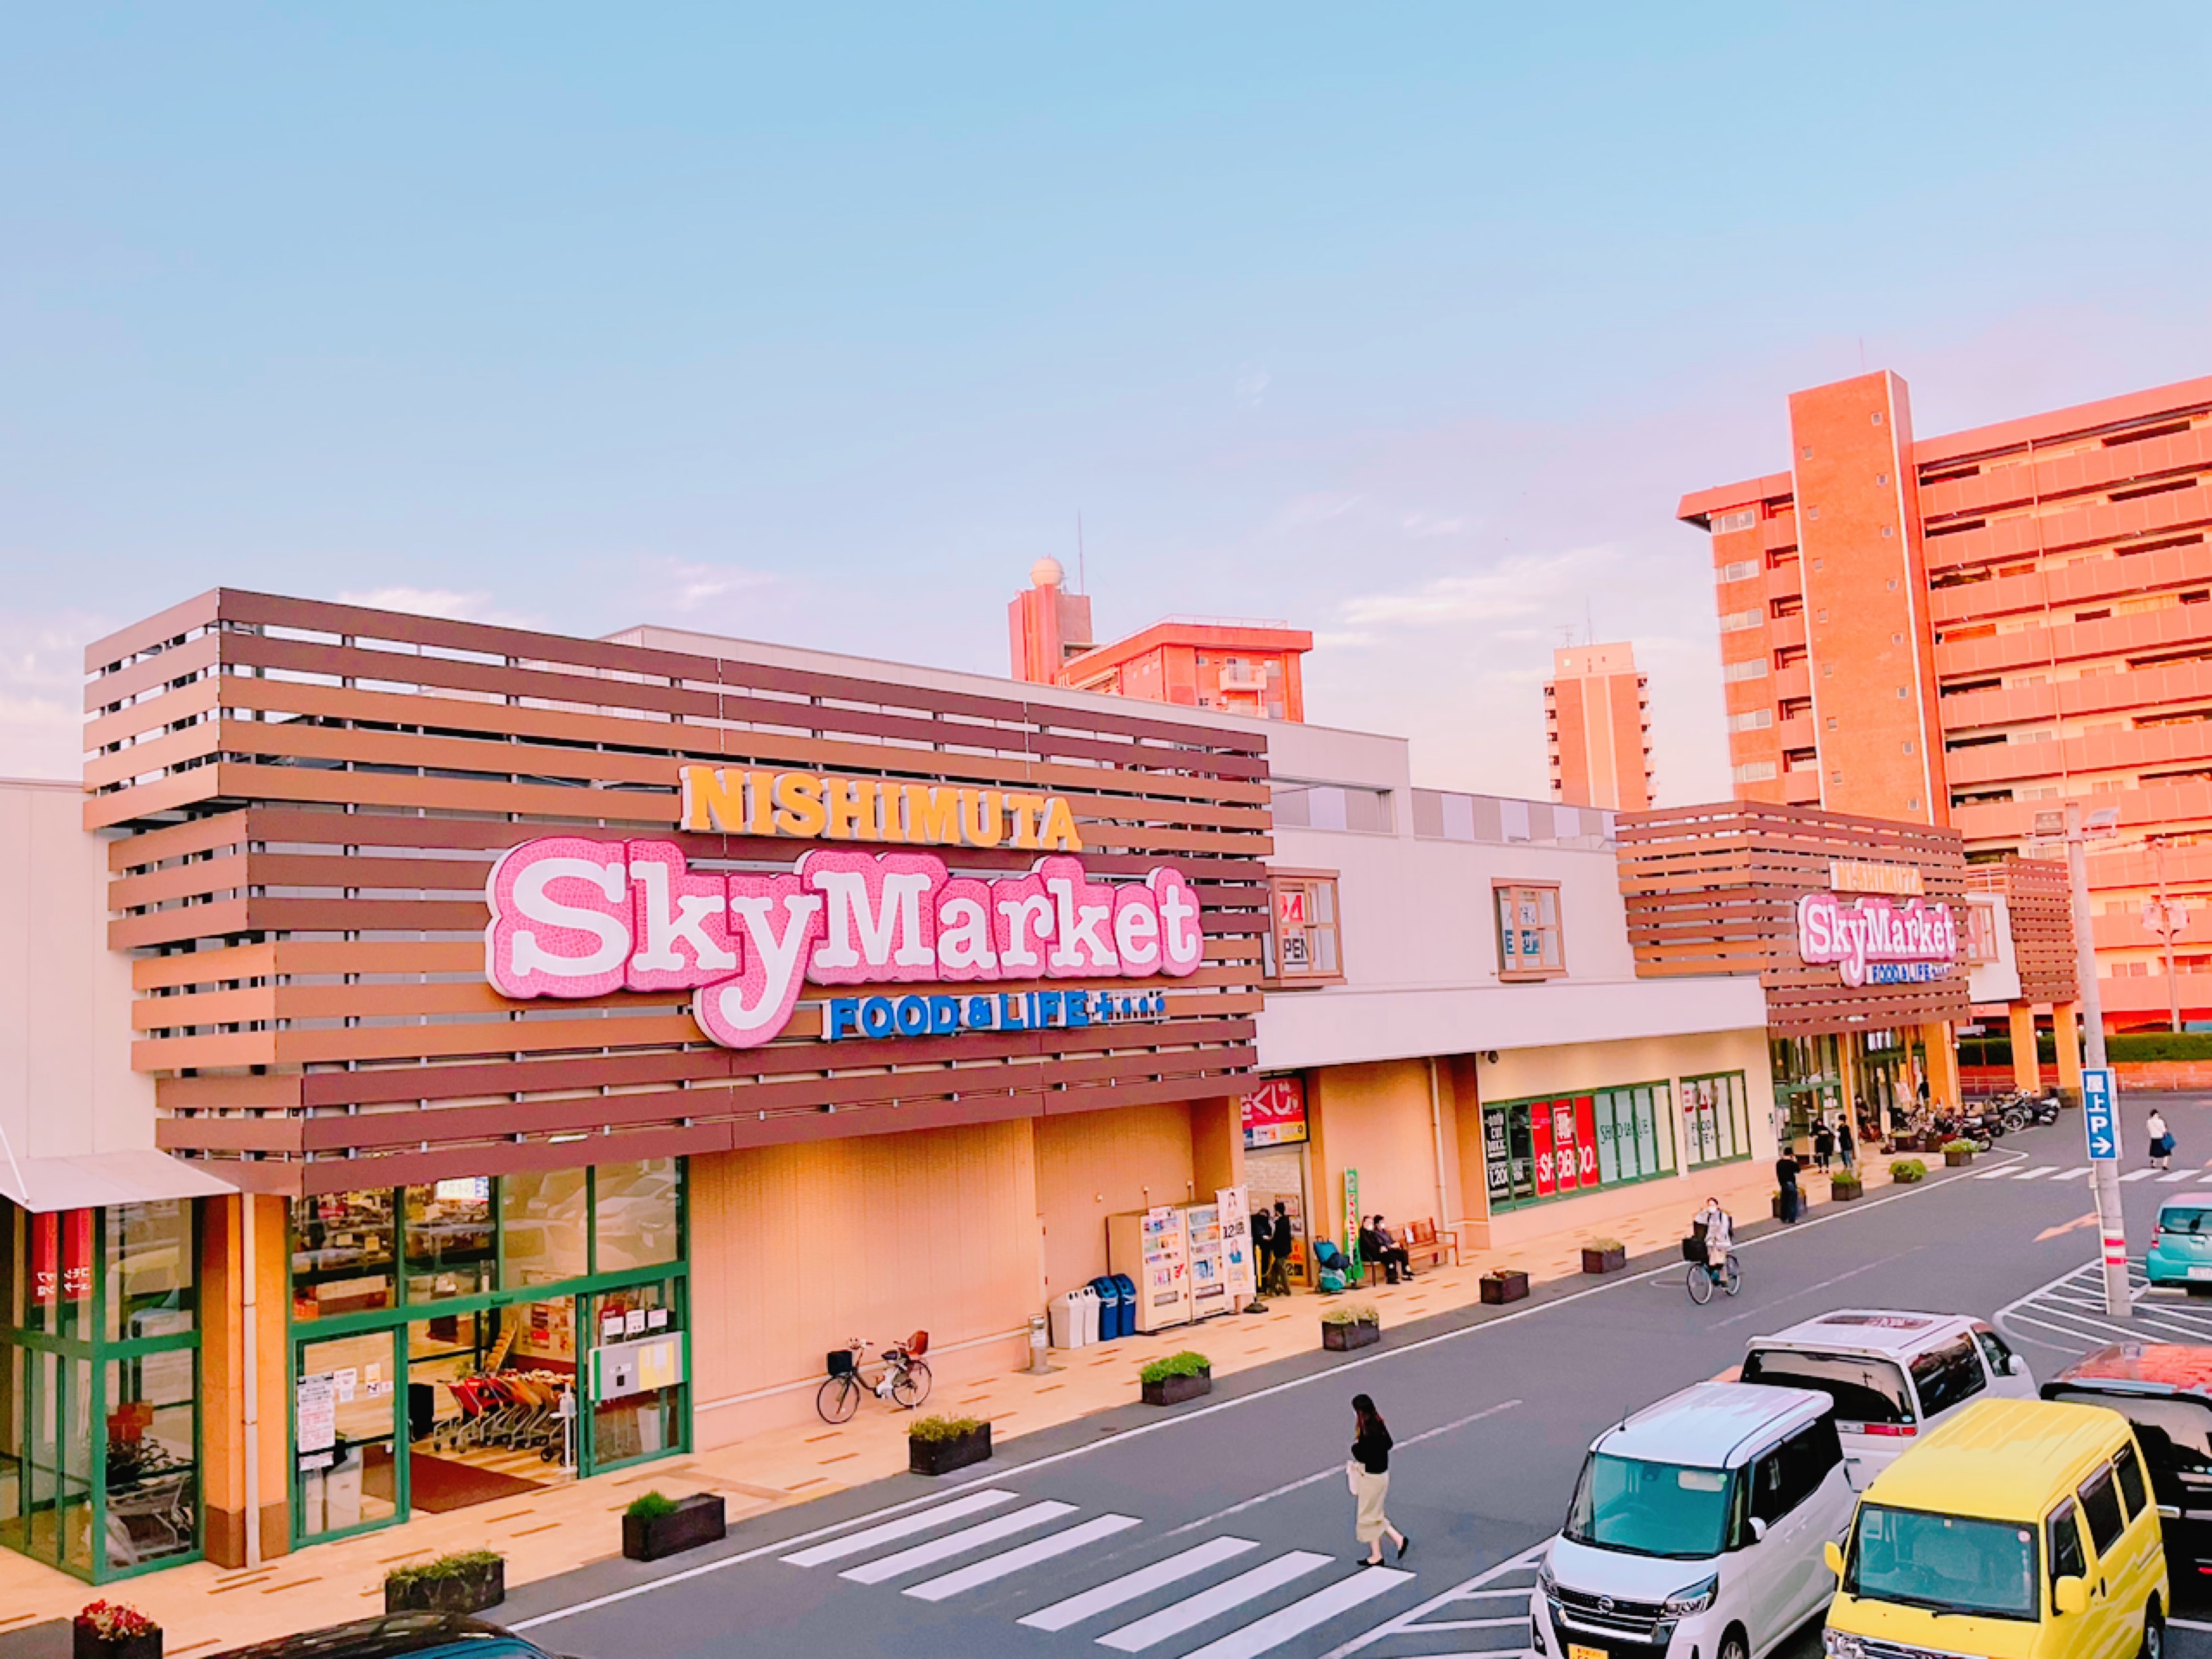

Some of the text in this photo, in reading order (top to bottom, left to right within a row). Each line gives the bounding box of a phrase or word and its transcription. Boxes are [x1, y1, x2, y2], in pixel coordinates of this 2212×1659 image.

[682, 765, 1083, 852] NISHIMUTA
[509, 855, 1197, 1030] SkyMarket
[1806, 903, 1955, 980] SkyMarket
